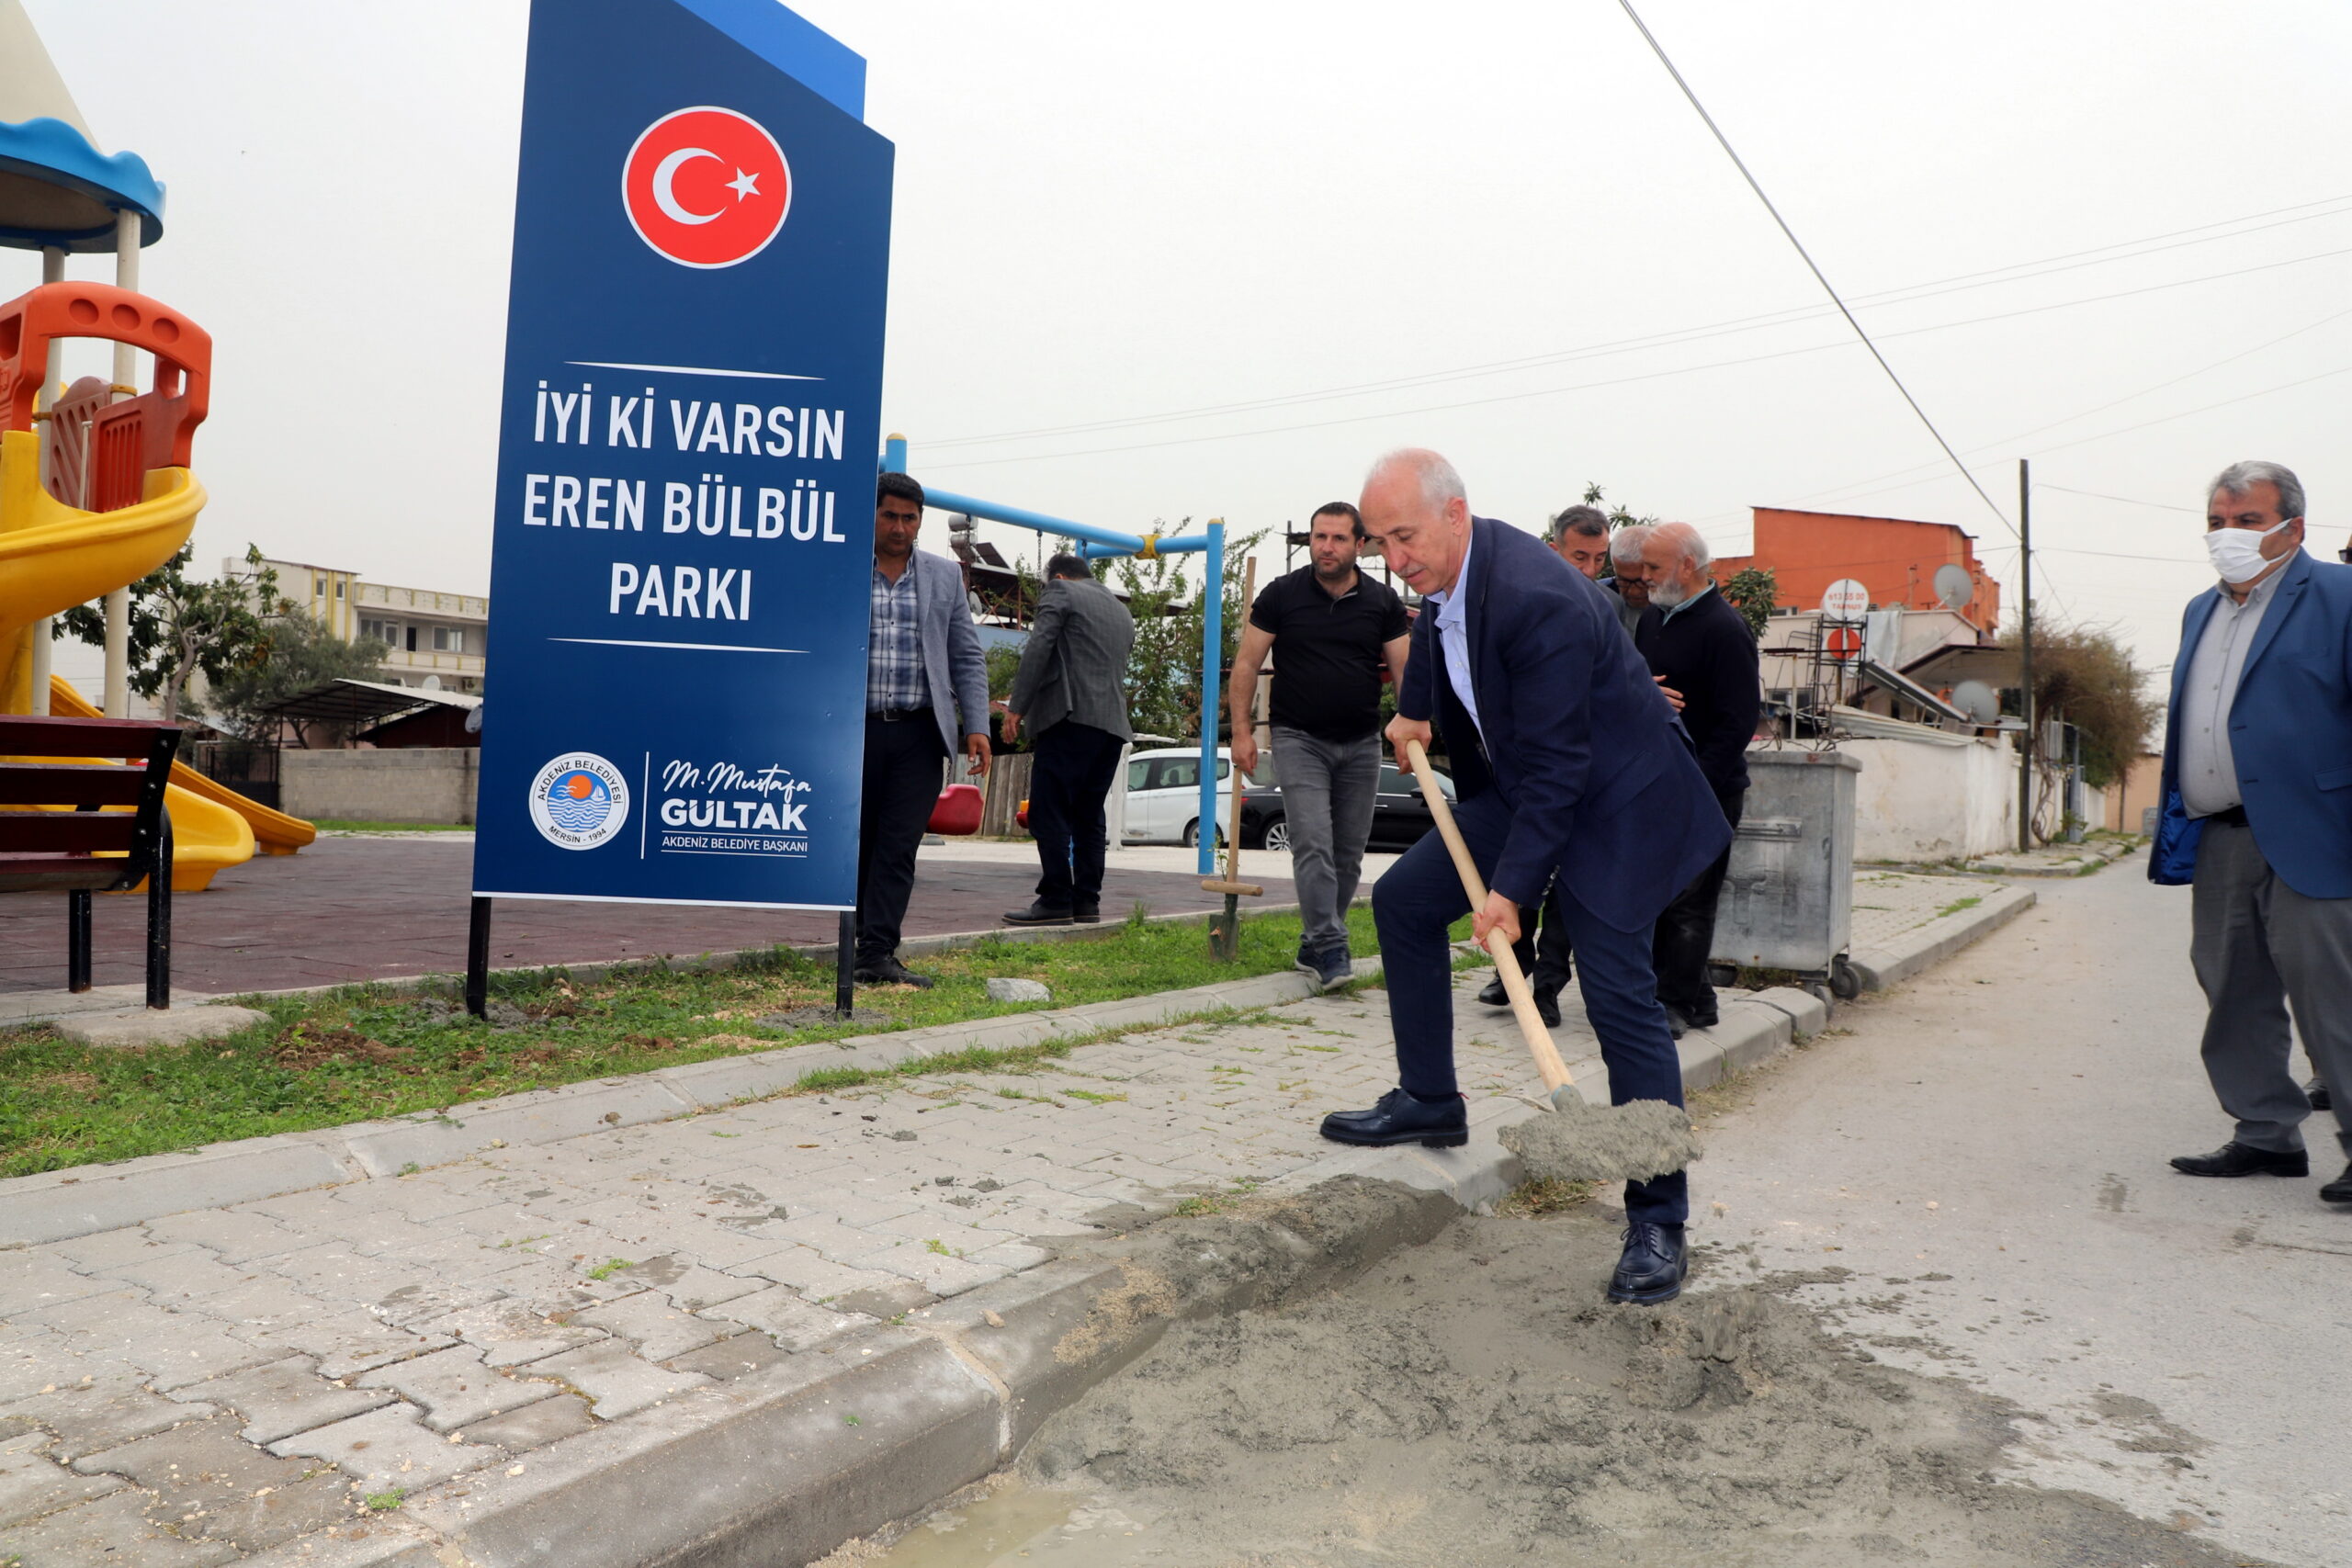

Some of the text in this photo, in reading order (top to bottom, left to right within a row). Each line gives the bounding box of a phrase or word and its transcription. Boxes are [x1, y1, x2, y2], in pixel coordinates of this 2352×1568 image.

[535, 380, 844, 459] İYİ Kİ VARSIN
[524, 474, 845, 543] EREN BÜLBÜL
[610, 562, 752, 621] PARKI
[537, 760, 624, 804] AKDENİZ BELEDİYESİ
[662, 760, 811, 804] M. Mustafa
[548, 825, 581, 843] MERSİN
[588, 828, 606, 841] 1994
[662, 836, 808, 852] AKDENİZ BELEDİYE BAŞKANI
